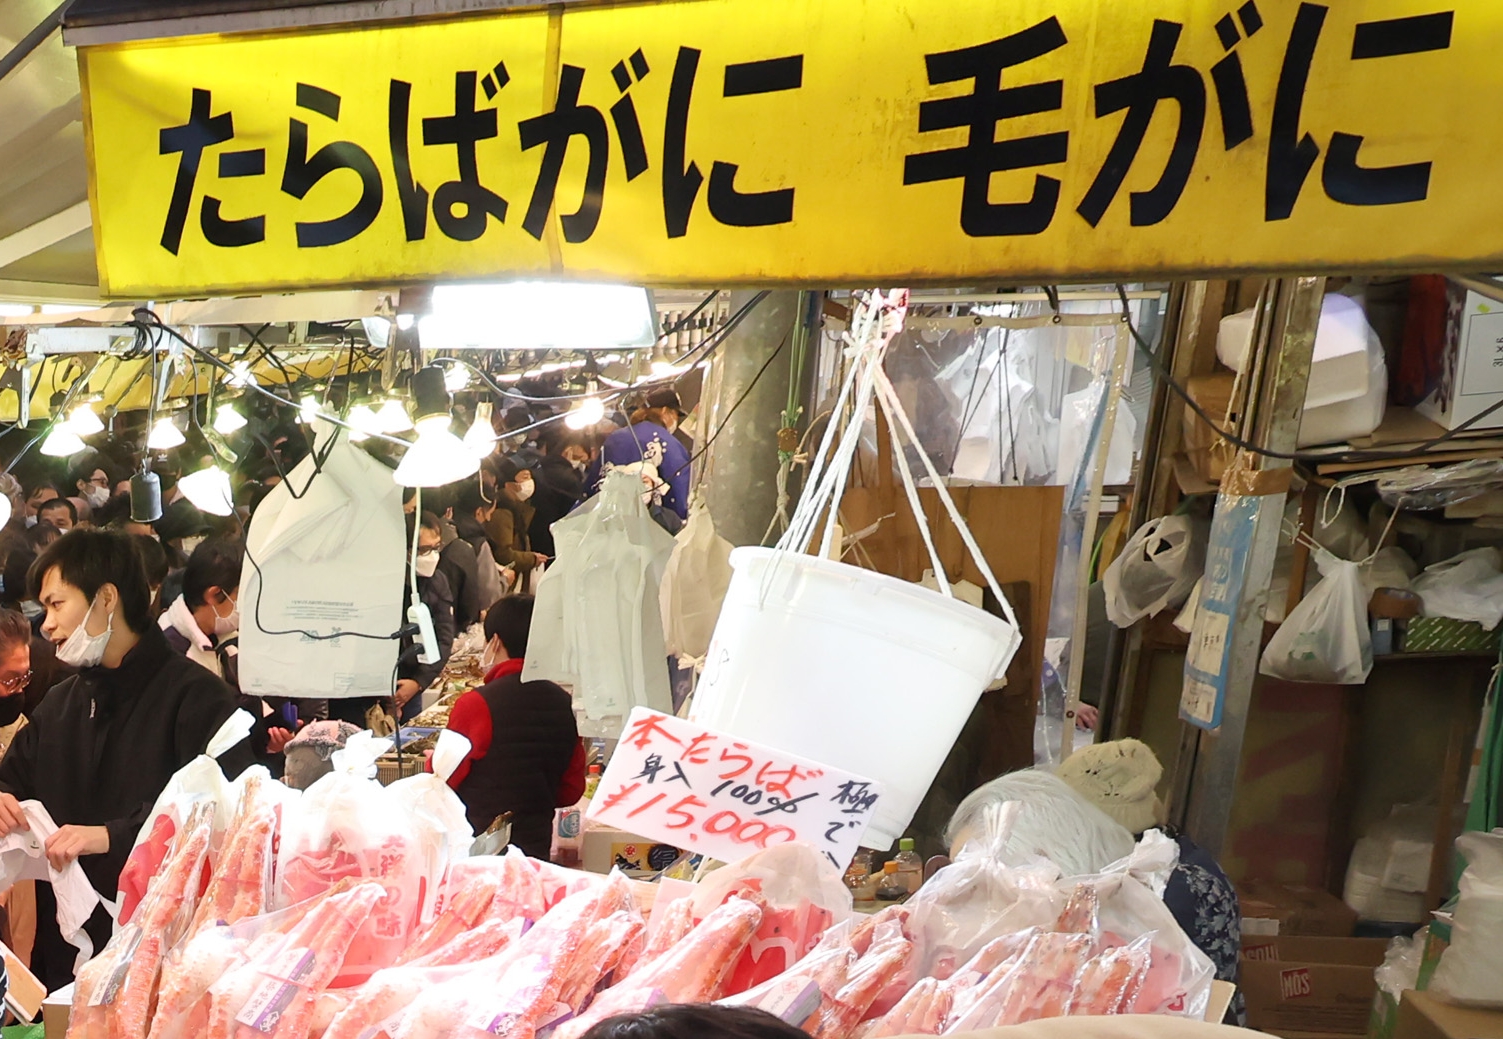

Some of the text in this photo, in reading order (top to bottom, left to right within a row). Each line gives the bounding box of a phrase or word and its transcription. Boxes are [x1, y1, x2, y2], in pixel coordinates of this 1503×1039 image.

[159, 1, 1454, 256] たらばがに 毛がに
[621, 714, 825, 800] 本たらば
[710, 780, 820, 816] 100%
